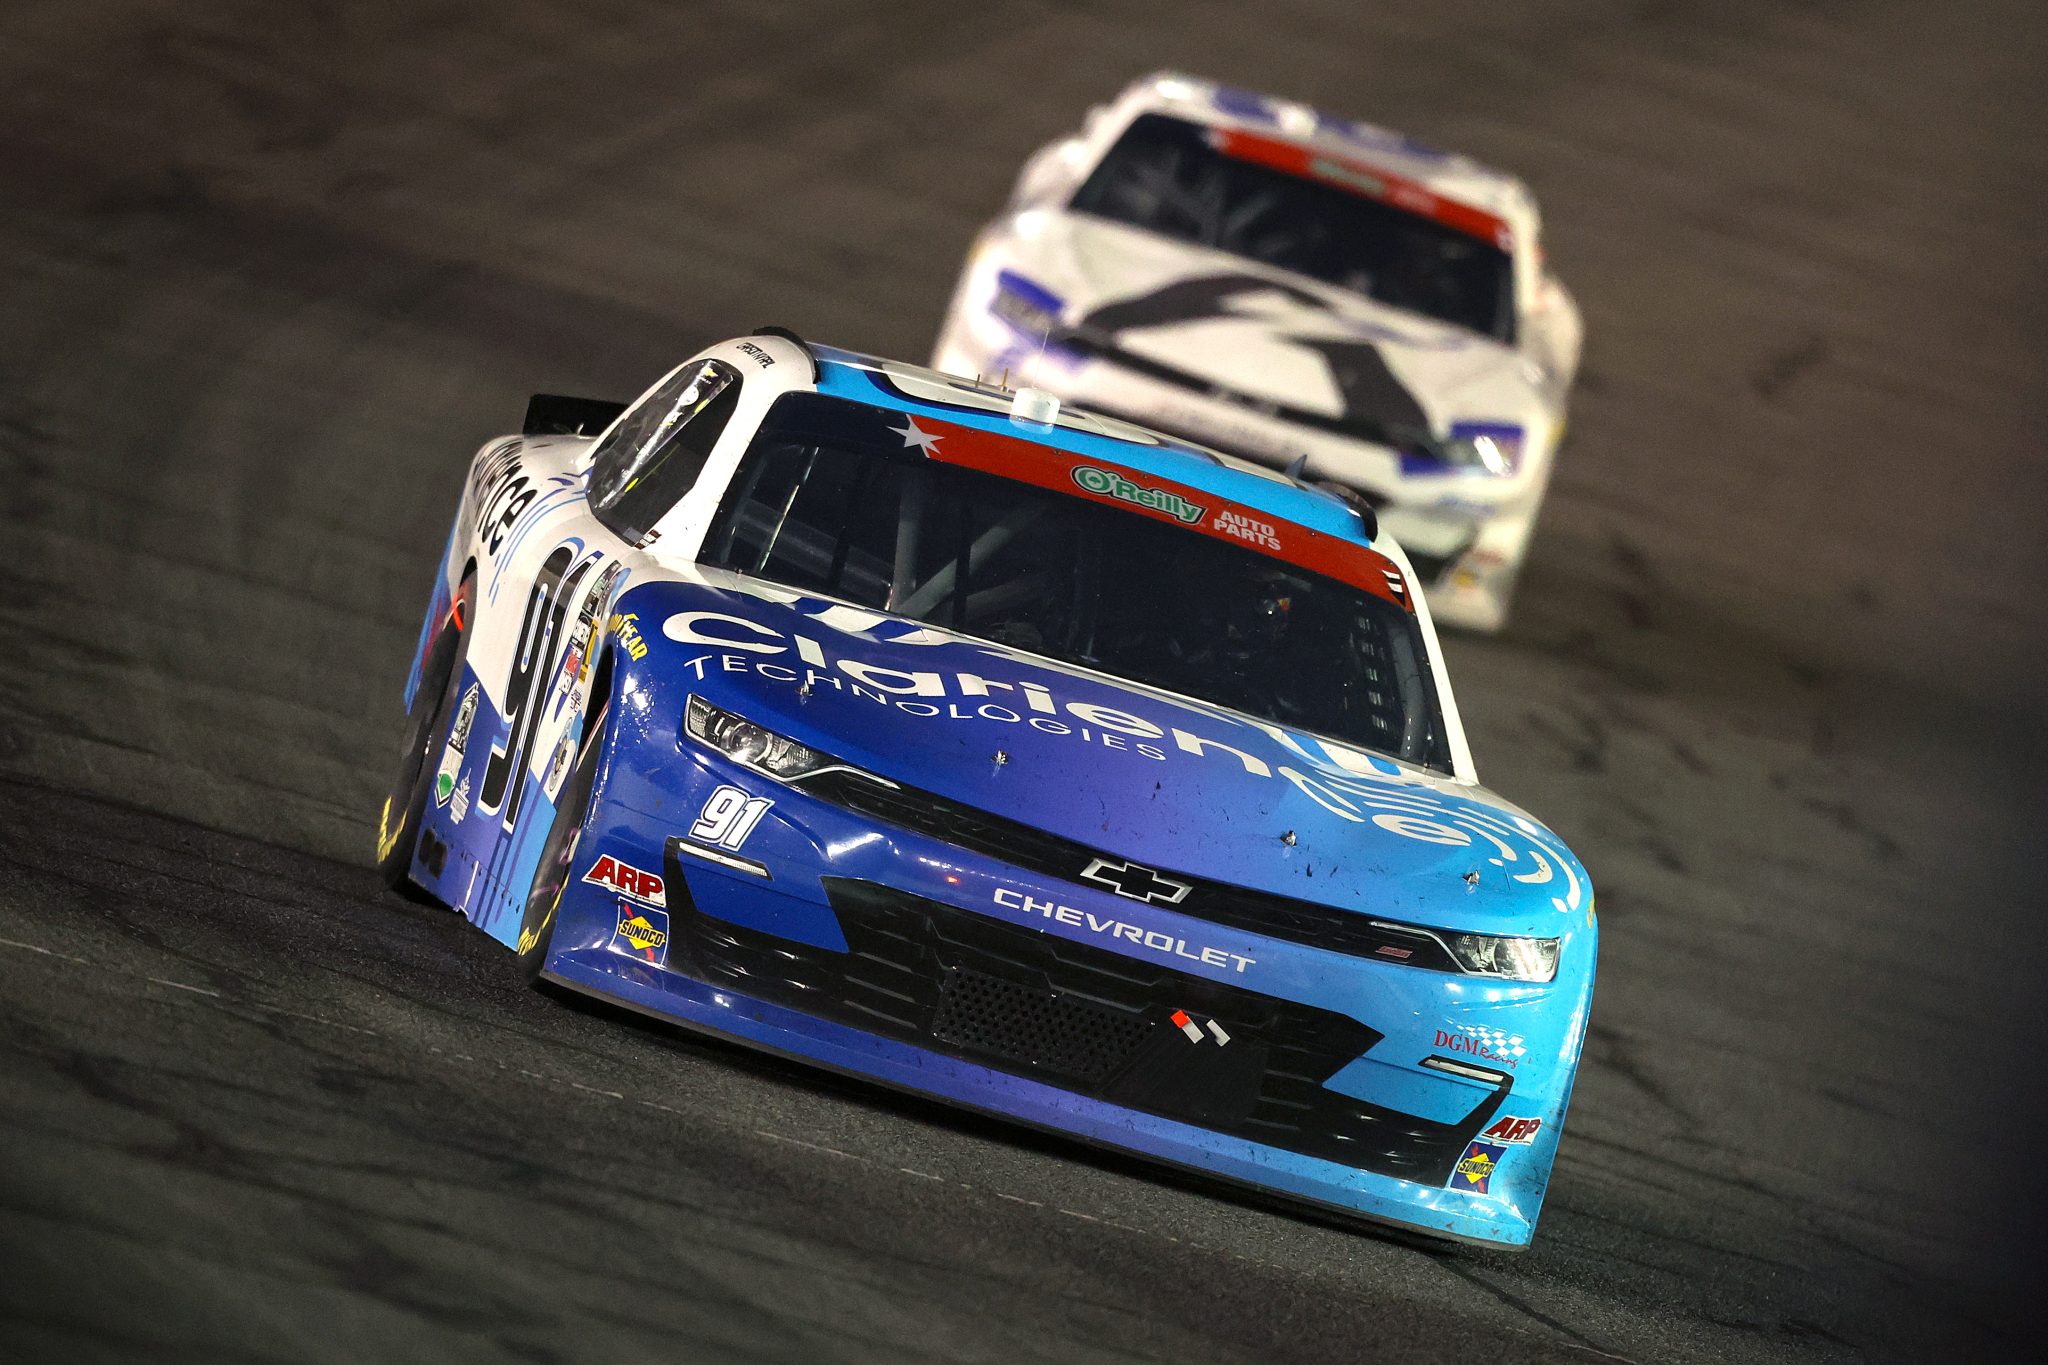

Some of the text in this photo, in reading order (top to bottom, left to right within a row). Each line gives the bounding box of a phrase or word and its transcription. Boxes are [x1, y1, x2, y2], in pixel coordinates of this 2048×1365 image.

[1073, 466, 1205, 524] O'Reilly
[1213, 518, 1282, 551] PARTS
[1221, 510, 1275, 537] AUTO
[683, 654, 1167, 761] TECHNOLOGIES
[688, 785, 776, 852] 91
[587, 855, 664, 899] ARP
[620, 921, 664, 946] SUNOCO
[993, 888, 1257, 973] CHEVROLET
[1433, 1030, 1519, 1070] DGM Racing
[1484, 1116, 1542, 1141] ARP
[1459, 1159, 1495, 1177] SUNOCO
